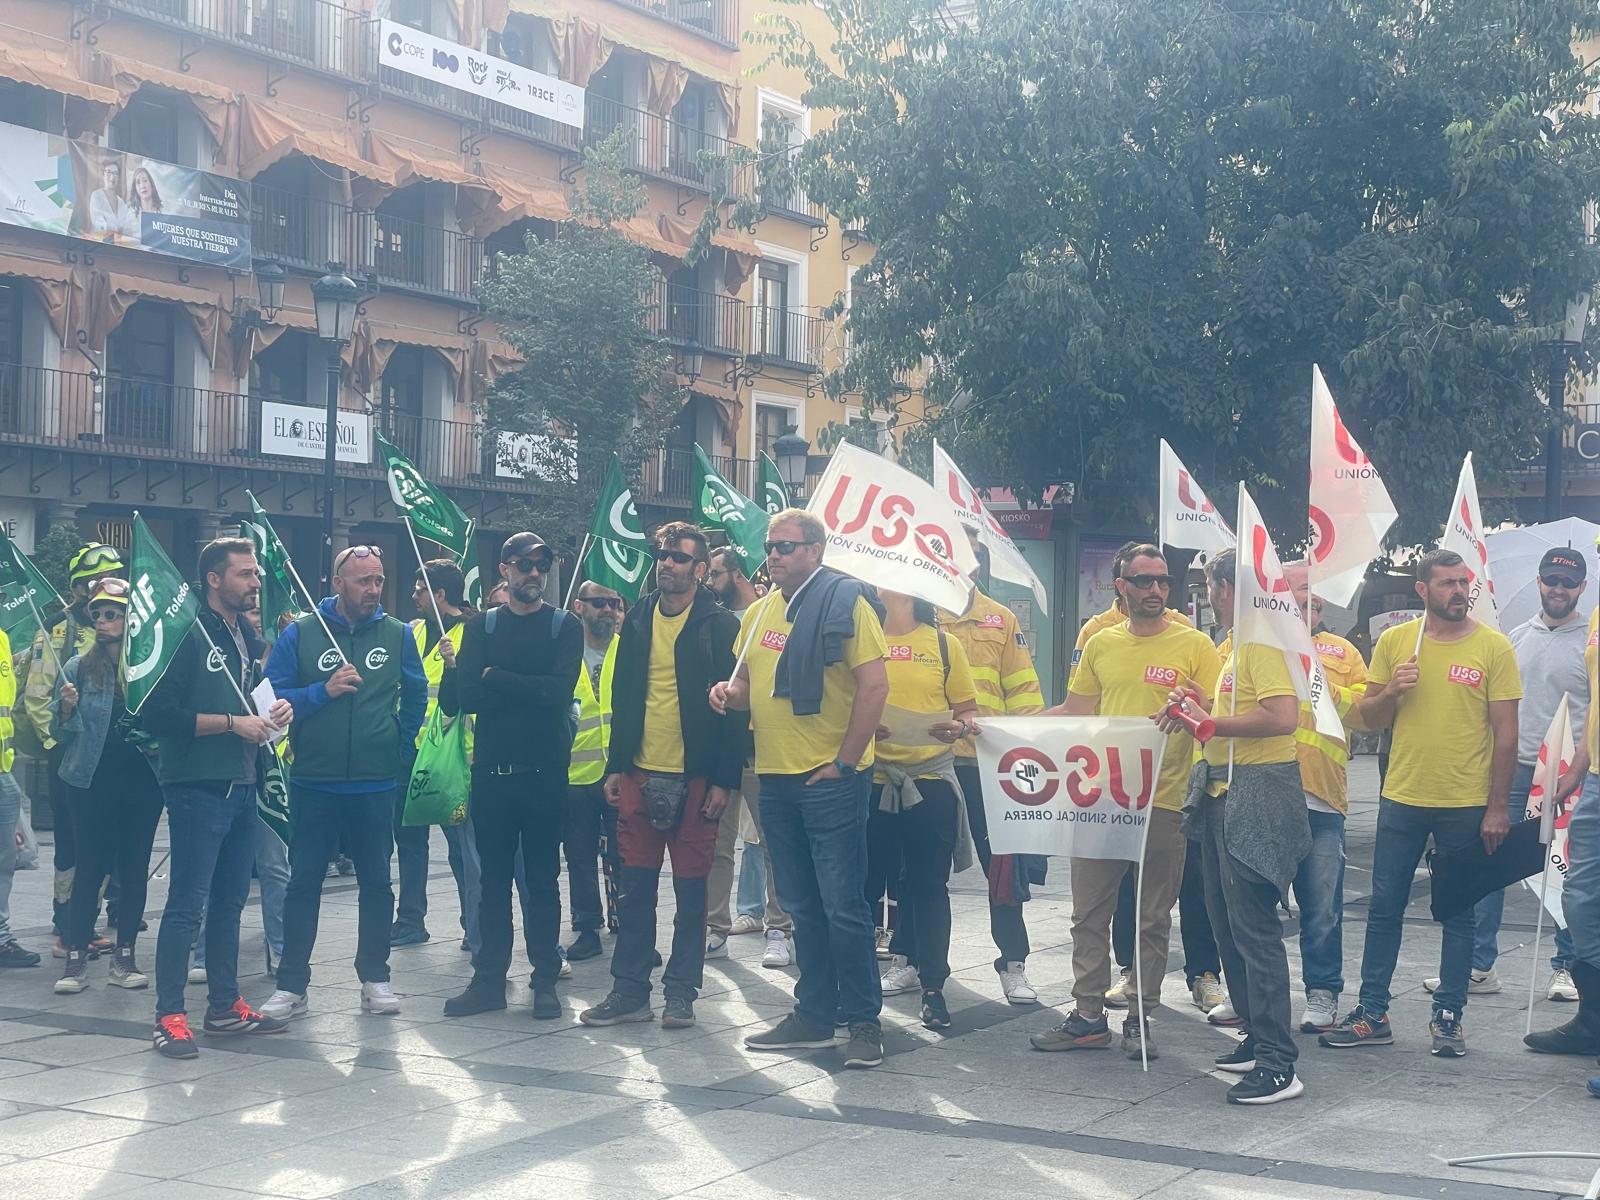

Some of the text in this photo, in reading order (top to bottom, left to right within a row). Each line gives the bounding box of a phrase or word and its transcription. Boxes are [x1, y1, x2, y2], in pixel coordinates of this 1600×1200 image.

[403, 42, 425, 59] COPE
[432, 47, 459, 73] 100
[467, 56, 488, 75] Rock
[200, 193, 238, 209] Internacional
[224, 188, 237, 201] Día
[211, 204, 239, 218] RURALES
[152, 221, 239, 247] MUJERES QUE SOSTIENEN
[171, 235, 230, 255] NUESTRA TIERRA
[274, 416, 358, 446] EL ESPÑOL
[1333, 466, 1380, 480] UNIÓN
[417, 511, 454, 538] Toledo
[1000, 511, 1031, 522] KIOSKO
[823, 474, 961, 577] USO
[853, 544, 909, 565] SINDICAL
[1551, 556, 1578, 567] STIHL
[165, 582, 189, 618] Toledo
[1253, 594, 1291, 614] UNIÓN
[1316, 643, 1344, 654] USO
[370, 653, 390, 663] CSIF
[1146, 665, 1177, 681] USO
[1450, 665, 1481, 681] USO
